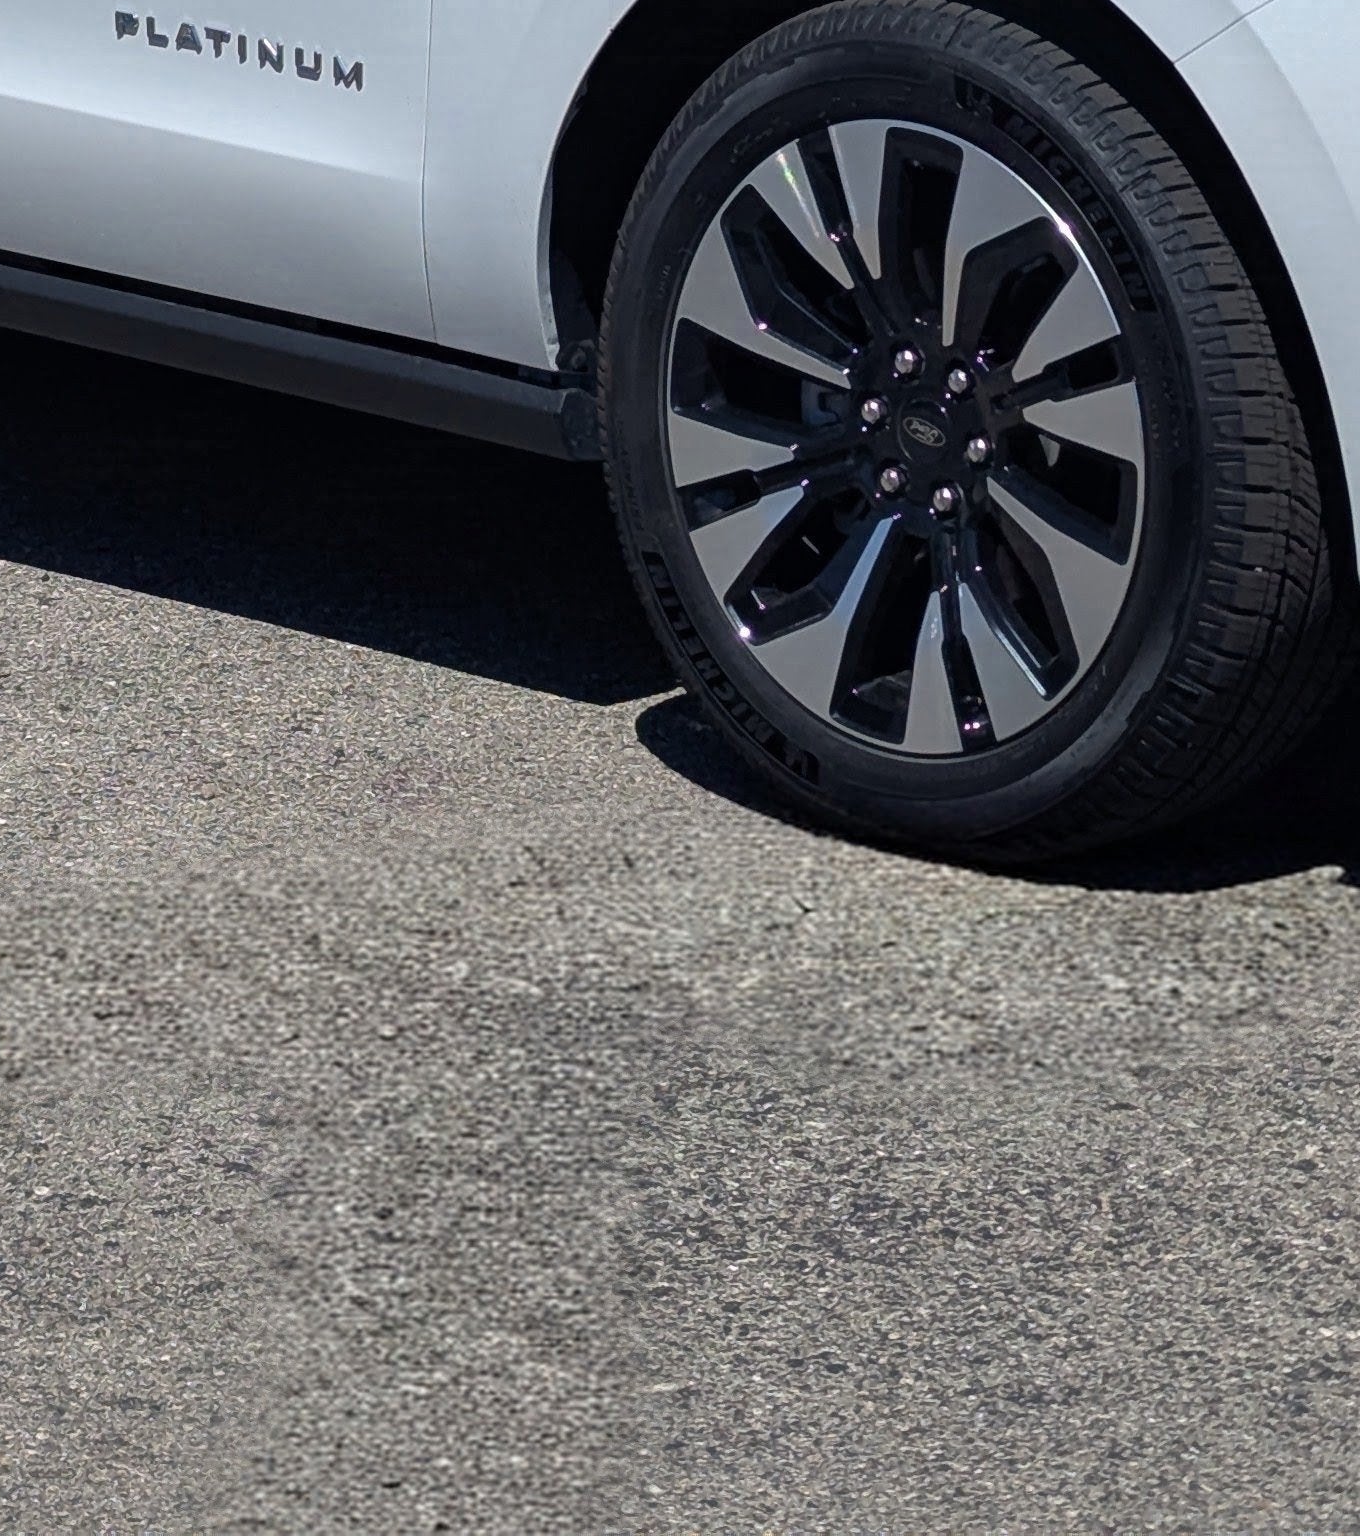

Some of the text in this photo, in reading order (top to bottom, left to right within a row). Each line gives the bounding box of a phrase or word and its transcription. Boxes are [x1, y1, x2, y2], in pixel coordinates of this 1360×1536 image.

[114, 9, 364, 92] PLATINUM
[1002, 114, 1152, 296] MICHELIN
[646, 562, 776, 745] MICHELIN
